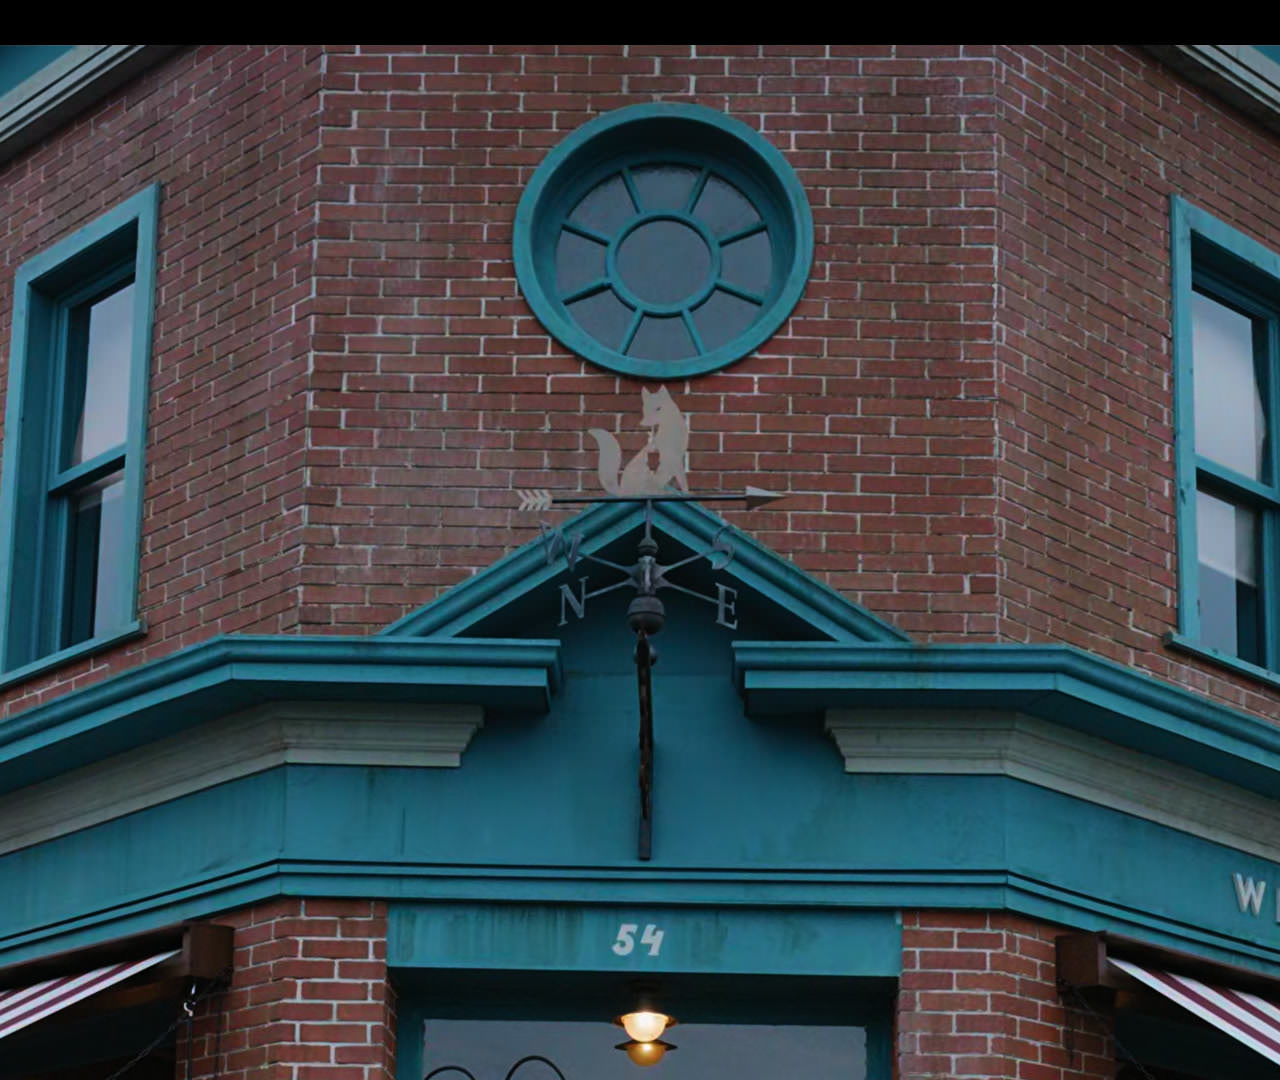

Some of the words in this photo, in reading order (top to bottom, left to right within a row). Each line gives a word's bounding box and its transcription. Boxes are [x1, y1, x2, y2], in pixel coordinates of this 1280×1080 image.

[557, 576, 590, 627] N
[715, 582, 738, 630] E
[611, 923, 665, 956] 54
